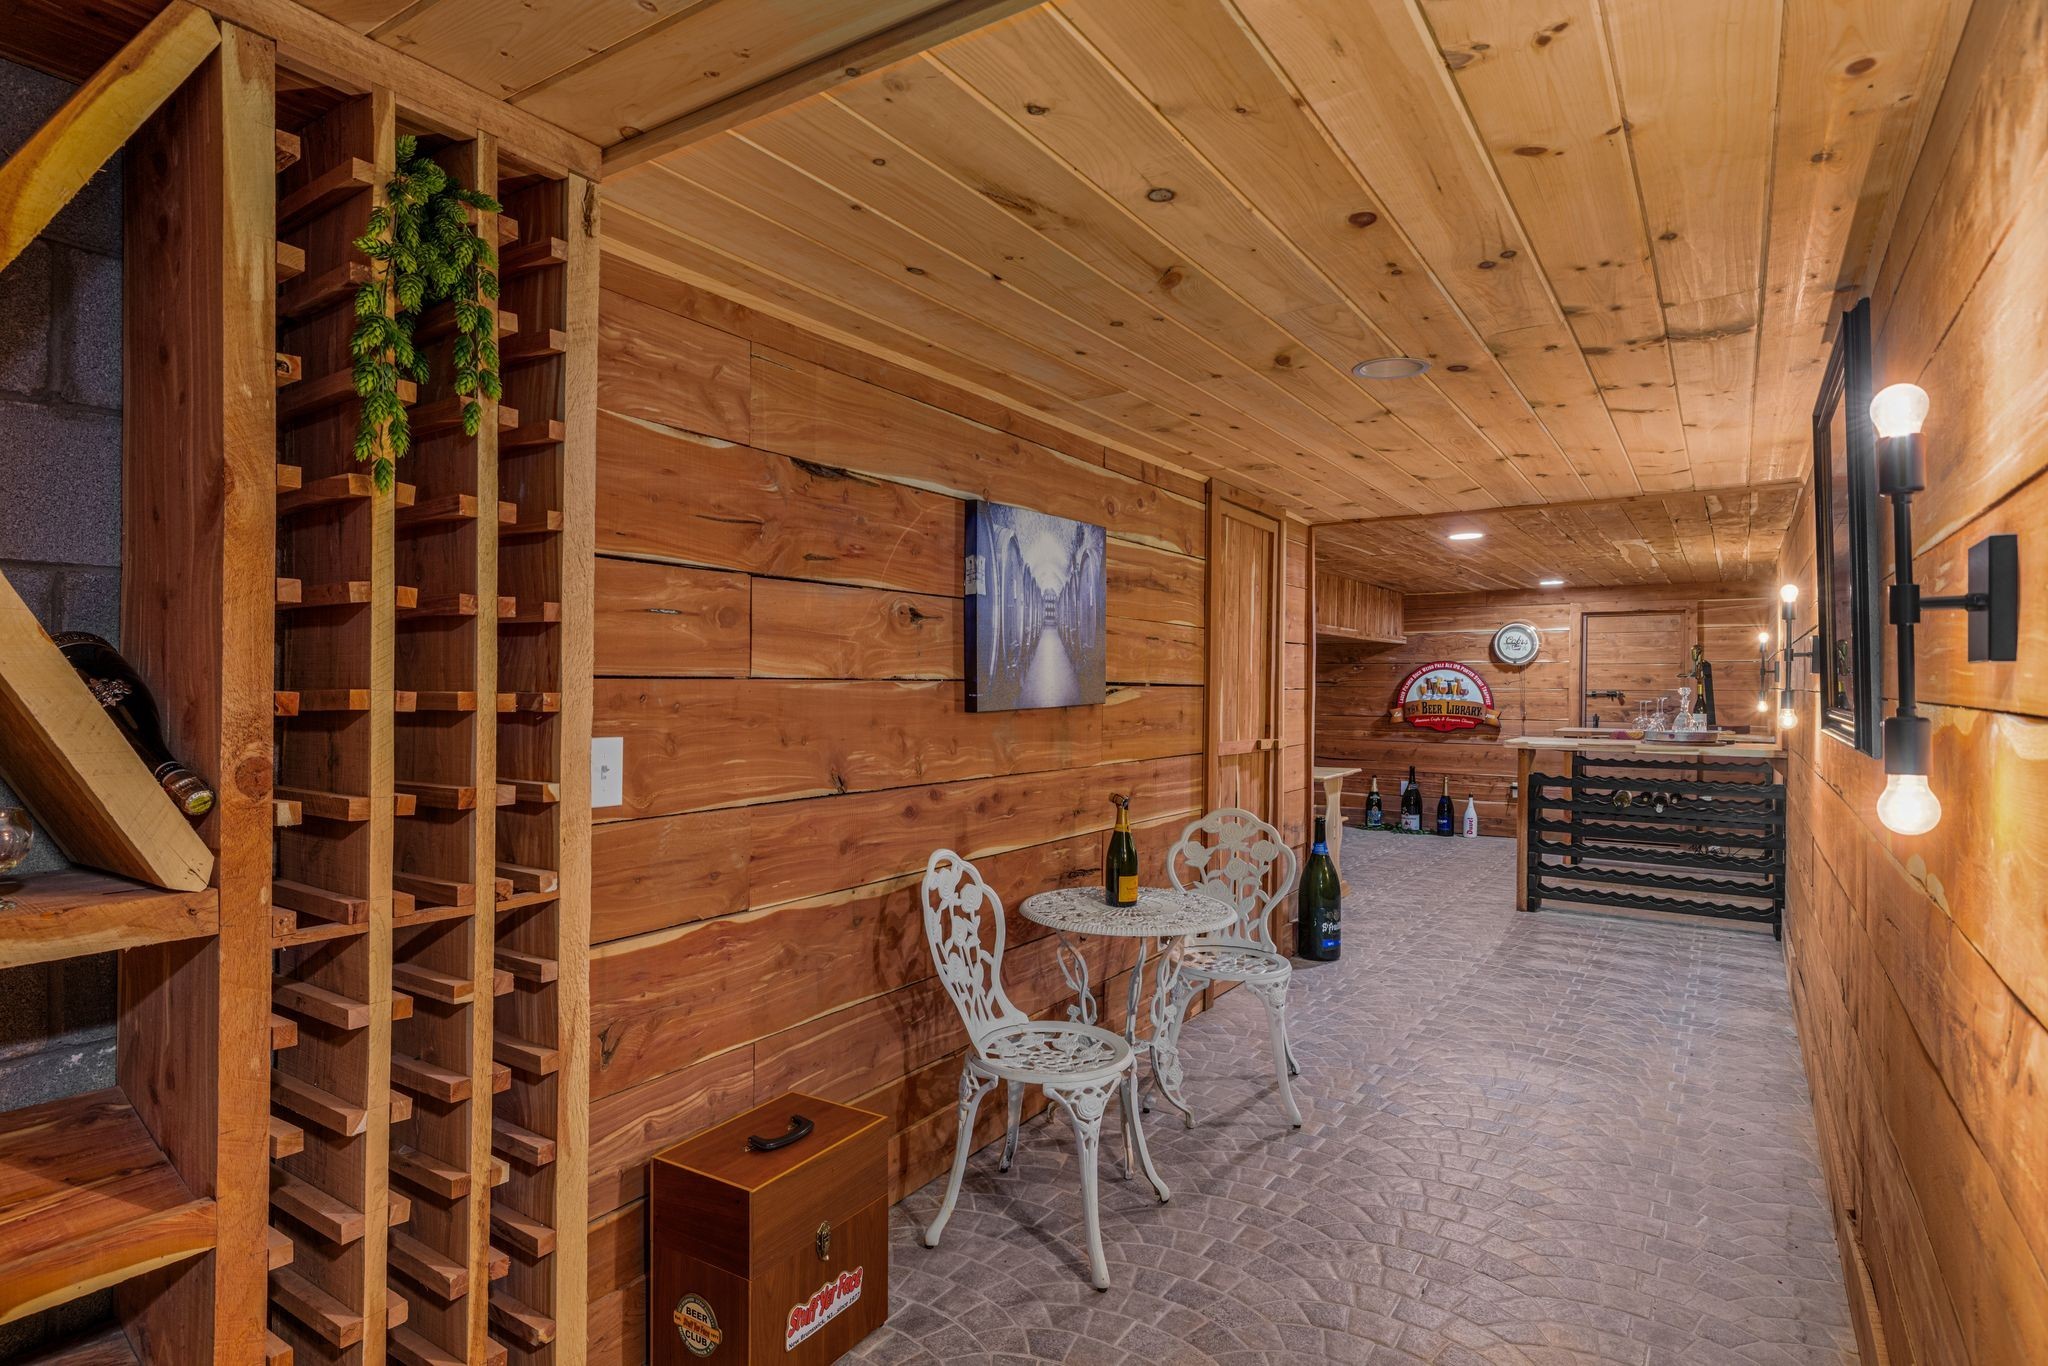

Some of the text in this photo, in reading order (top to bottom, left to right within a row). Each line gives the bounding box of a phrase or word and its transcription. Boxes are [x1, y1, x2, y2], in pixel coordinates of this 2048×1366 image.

[1422, 702, 1443, 714] BEER
[1466, 817, 1474, 835] Duvel
[837, 1267, 863, 1299] Face
[686, 1306, 708, 1324] BEER
[685, 1330, 708, 1346] CLUB
